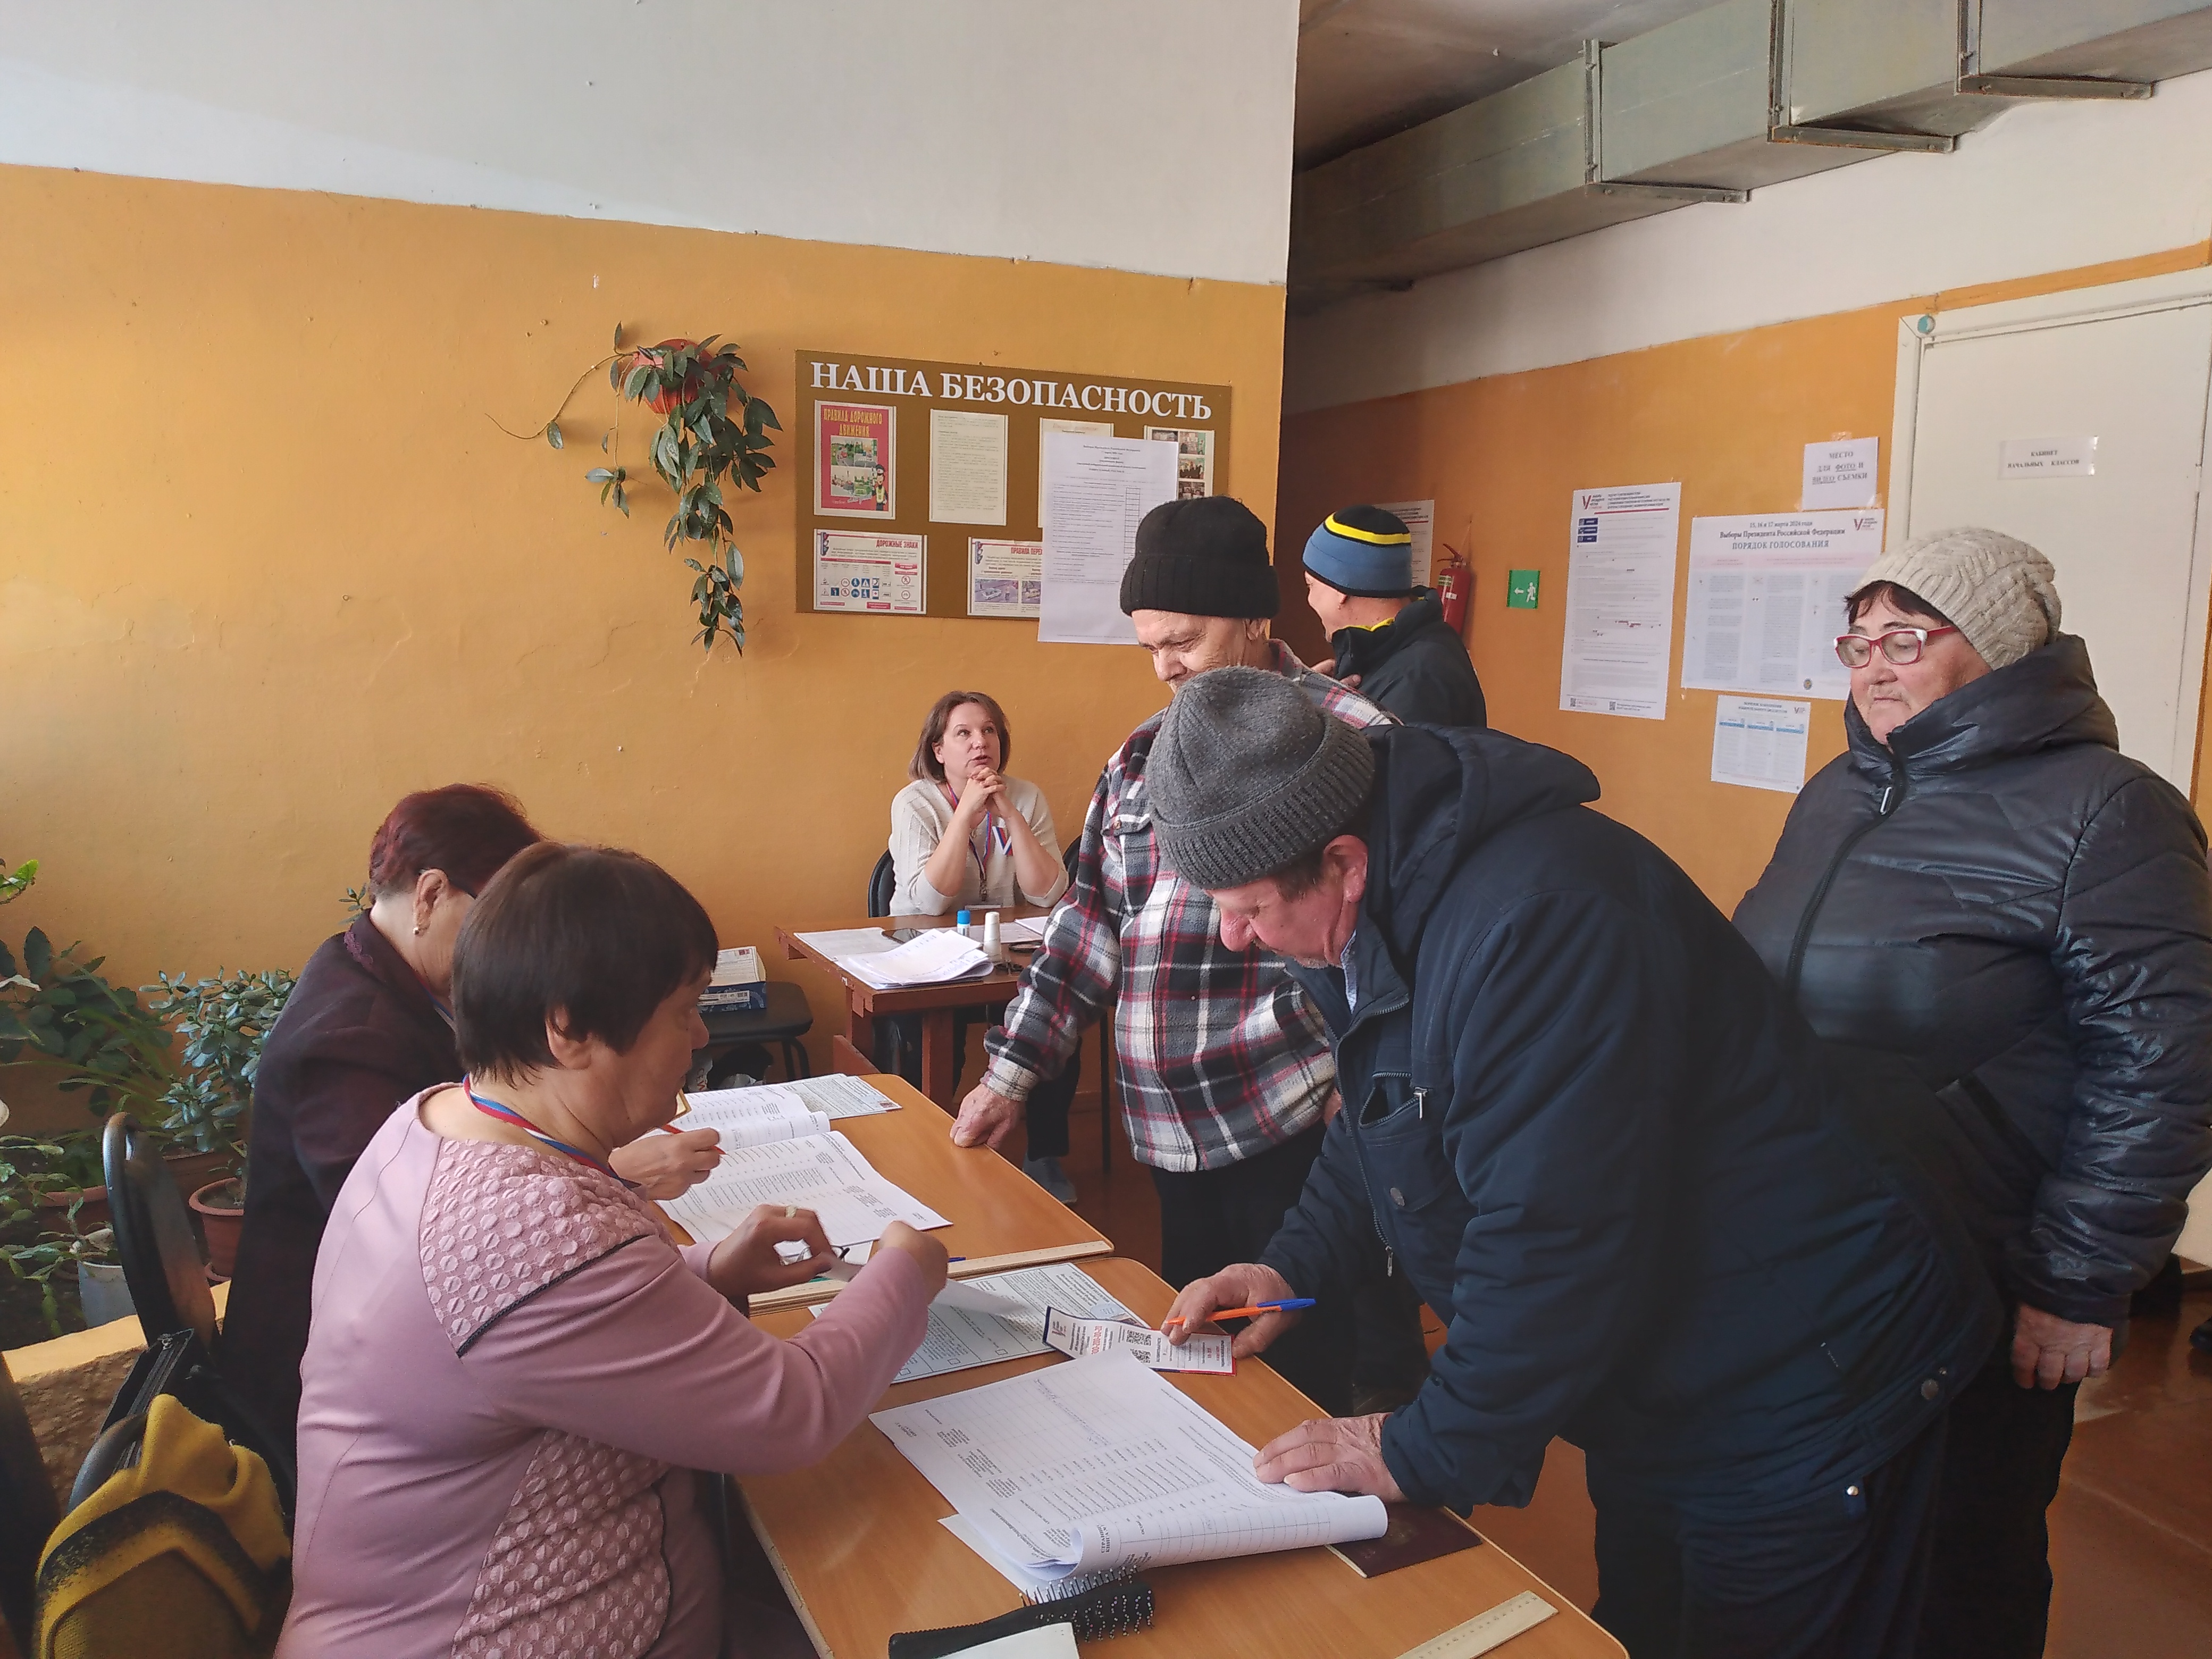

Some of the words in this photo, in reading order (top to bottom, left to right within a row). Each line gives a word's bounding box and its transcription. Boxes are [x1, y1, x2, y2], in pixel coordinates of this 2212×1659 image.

[810, 361, 933, 397] НАША
[940, 372, 1212, 420] БЕЗОПАСНОСТЬ
[824, 408, 848, 423] ПРАВИЛА
[850, 410, 883, 424] ДОРОЖНОГО
[839, 424, 869, 437] ДВИЖЕНИЯ
[876, 540, 902, 548] ДОРОЖНЫЕ
[1732, 541, 1767, 550] ПОРЯДОК
[1769, 540, 1829, 549] ГОЛОСОВАНИЯ
